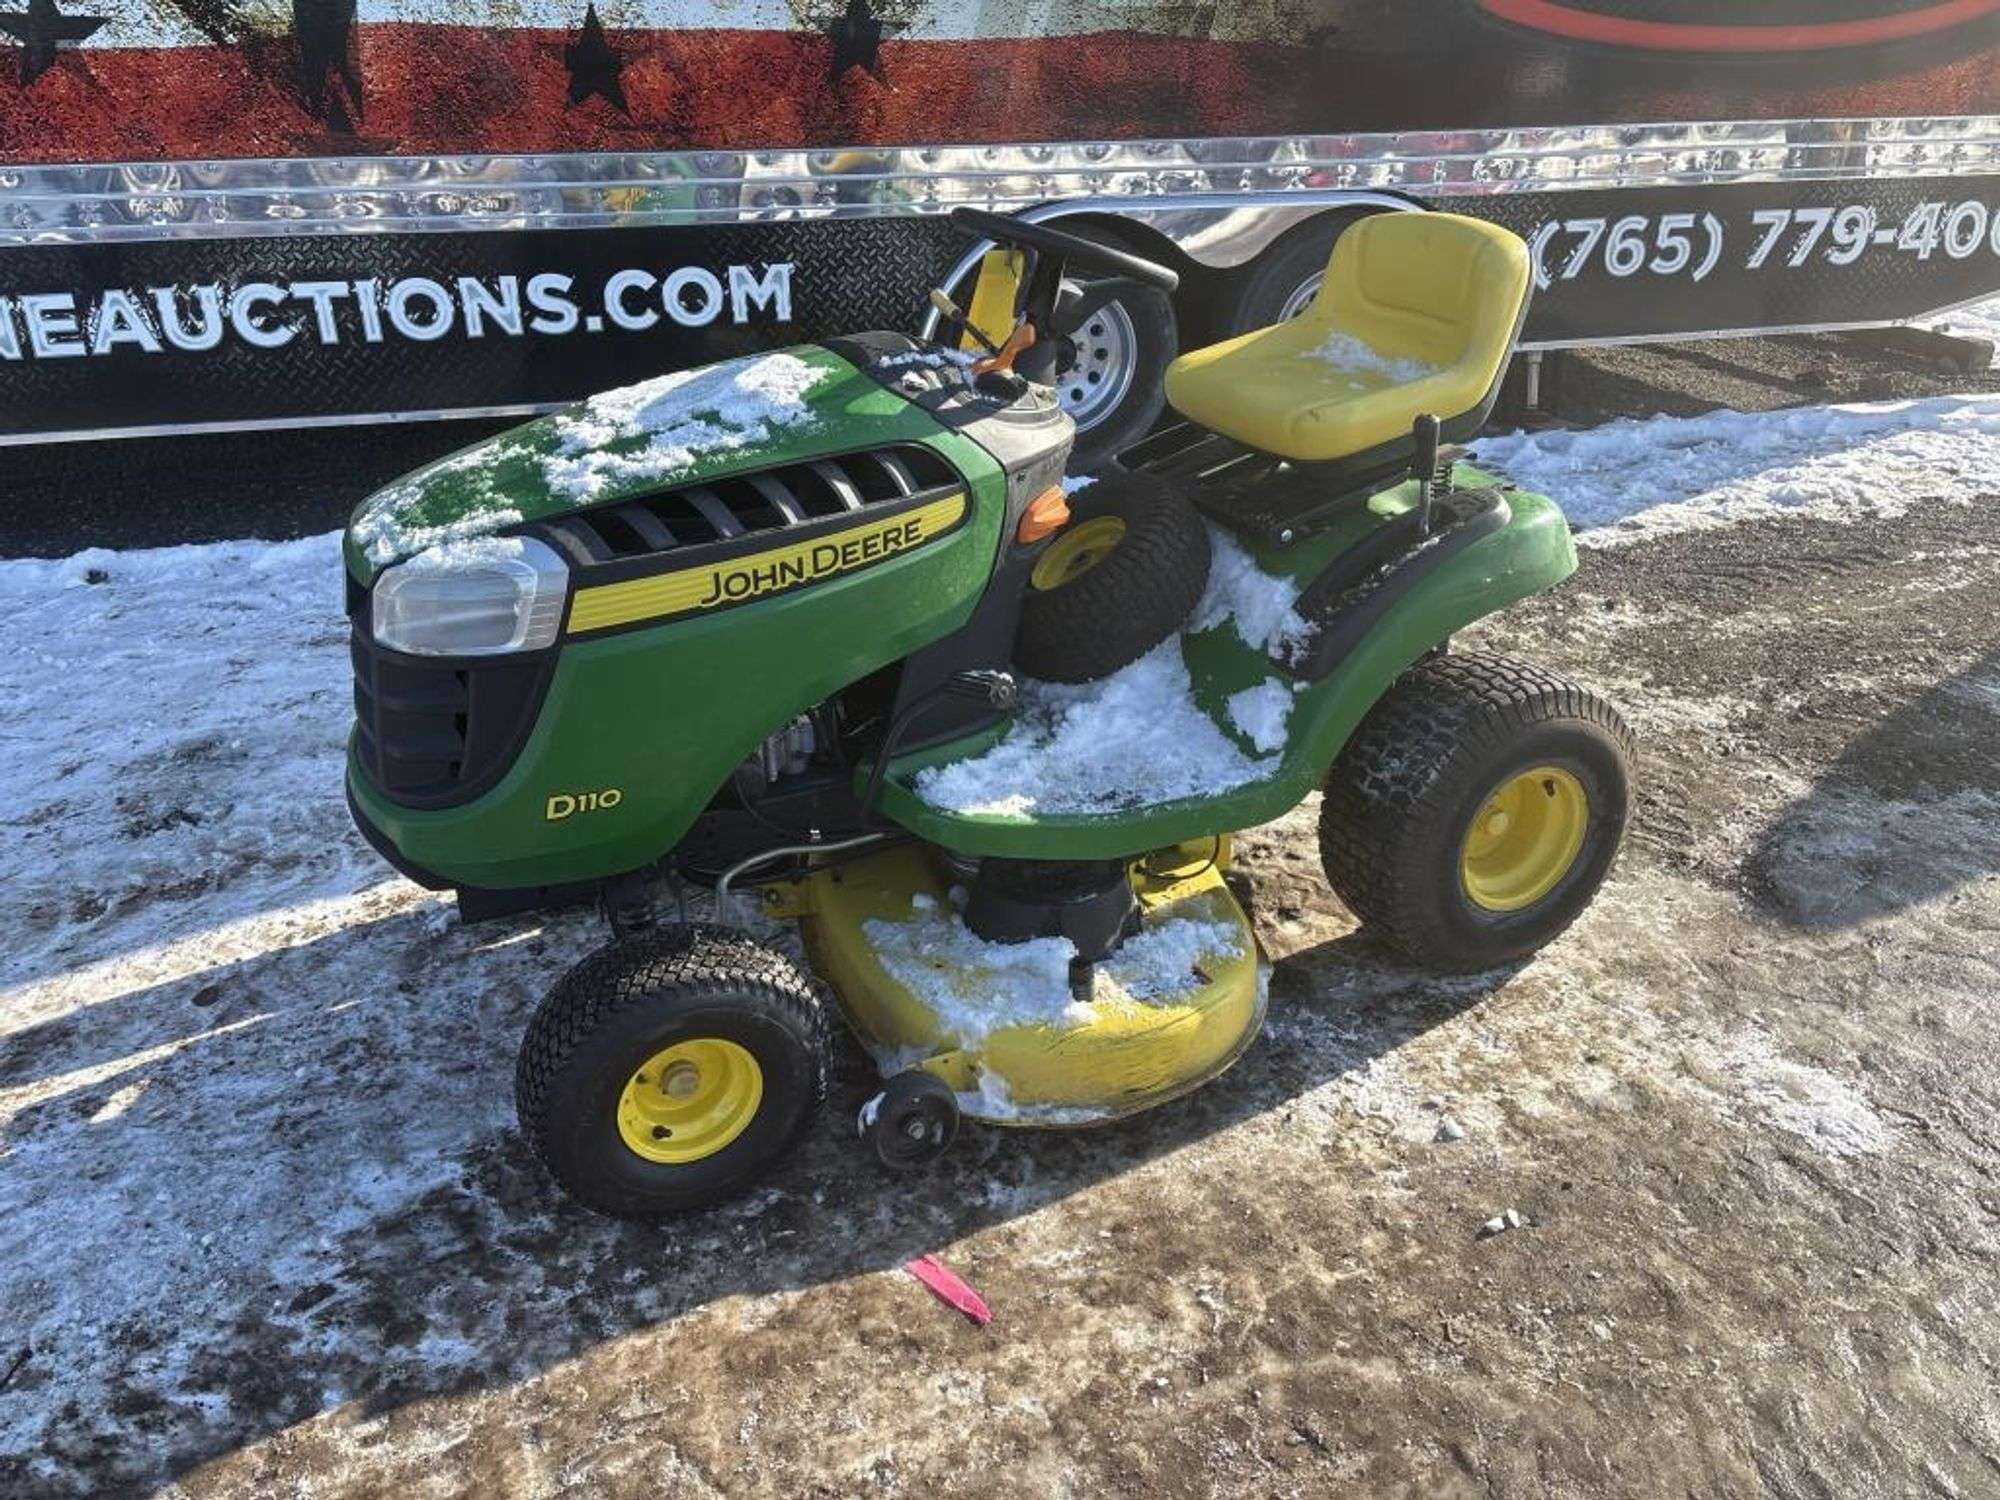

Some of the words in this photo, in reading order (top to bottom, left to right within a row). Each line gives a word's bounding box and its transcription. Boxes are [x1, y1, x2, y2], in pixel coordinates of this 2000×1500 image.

[1532, 211, 1723, 291] (765)
[1745, 200, 2000, 269] 779-40
[700, 556, 804, 606] JOHN
[812, 518, 922, 576] DEERE
[547, 789, 622, 820] D110
